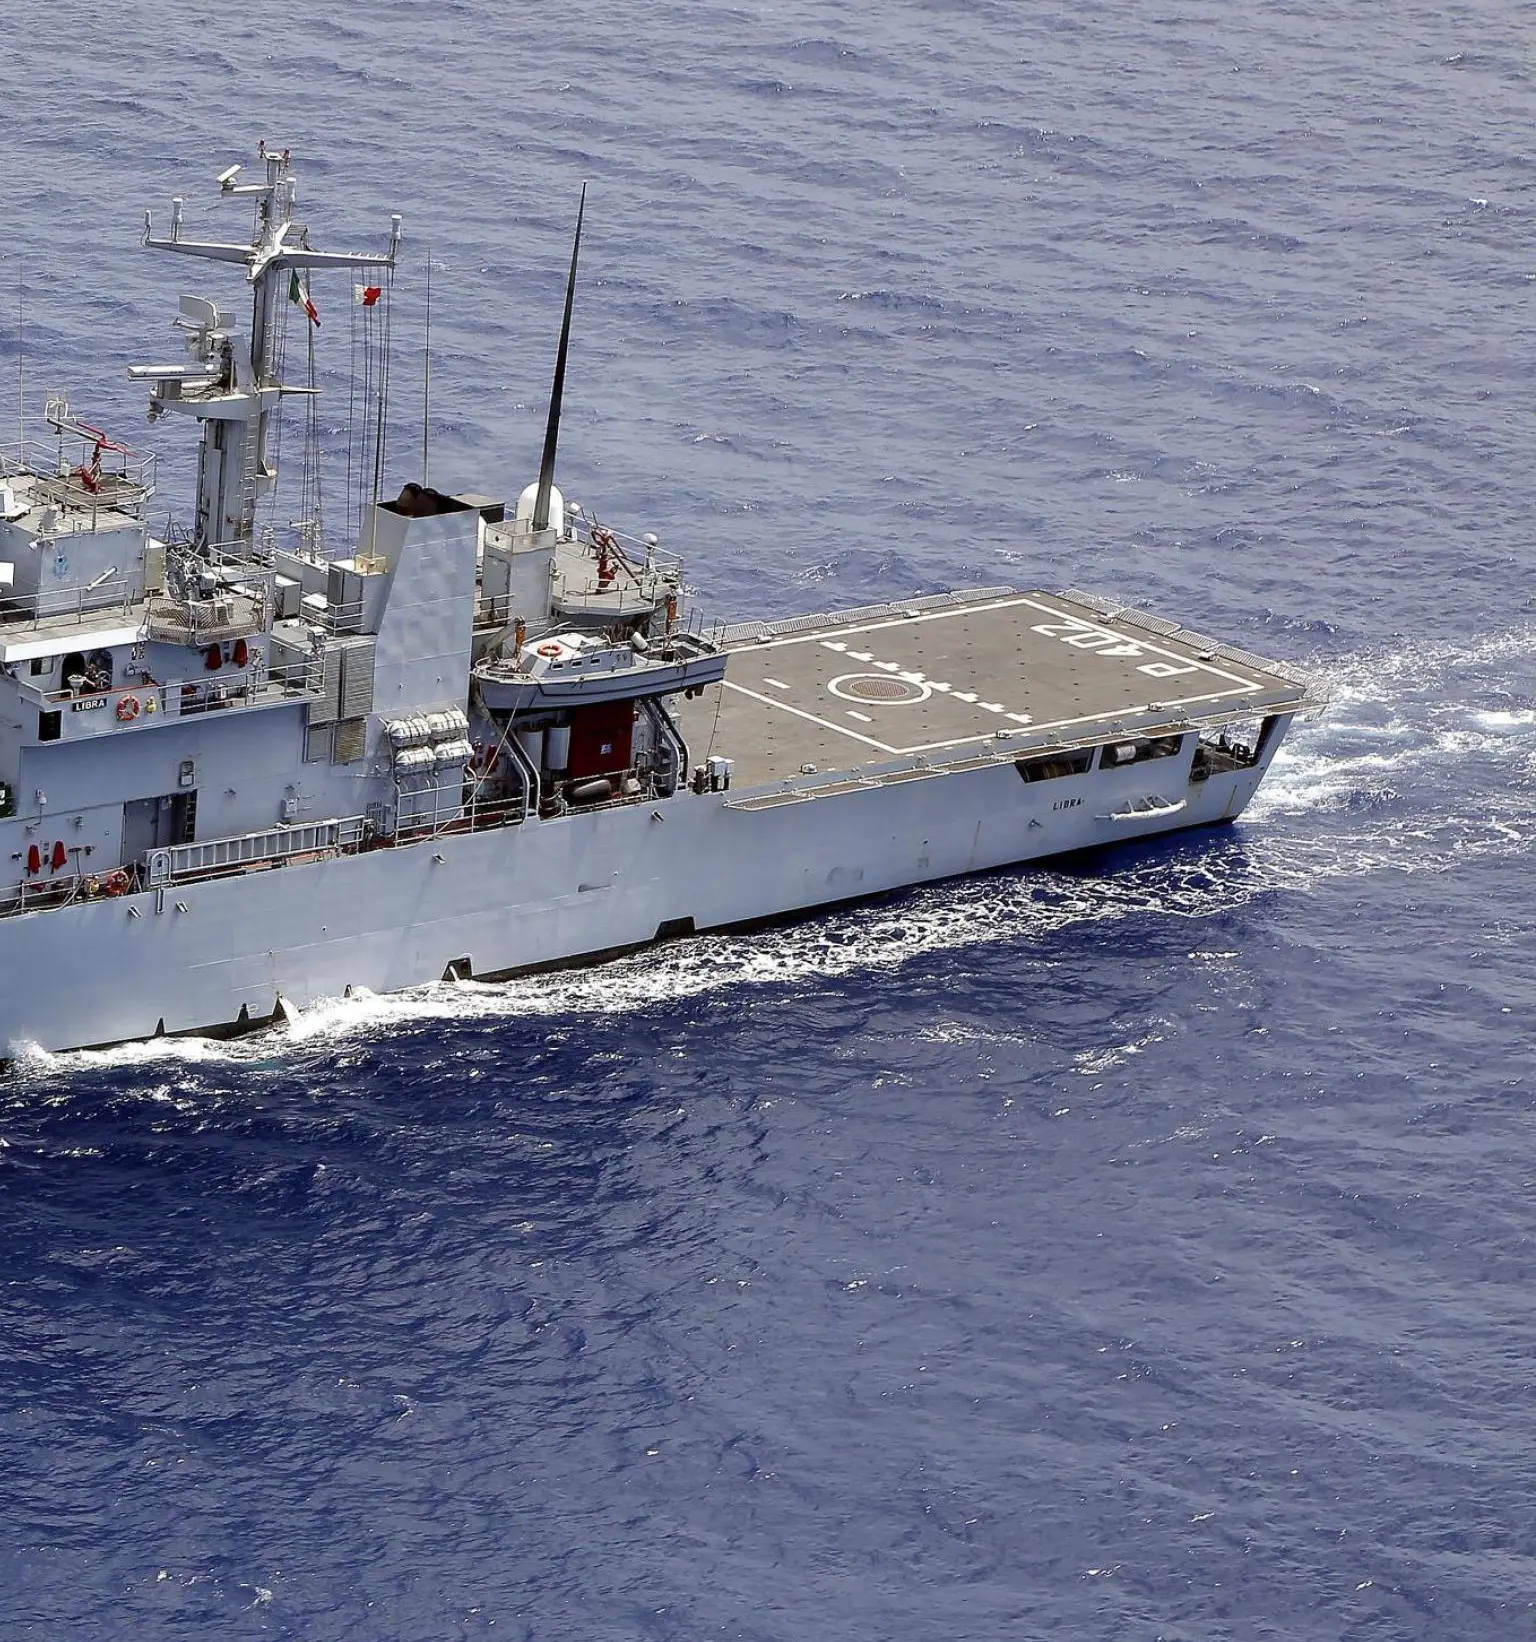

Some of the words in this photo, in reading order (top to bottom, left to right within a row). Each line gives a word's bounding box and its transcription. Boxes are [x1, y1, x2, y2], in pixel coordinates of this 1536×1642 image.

[1030, 620, 1145, 656] 402
[1136, 662, 1199, 678] P
[75, 699, 105, 711] LIBRA
[1053, 797, 1081, 810] LIBRA
